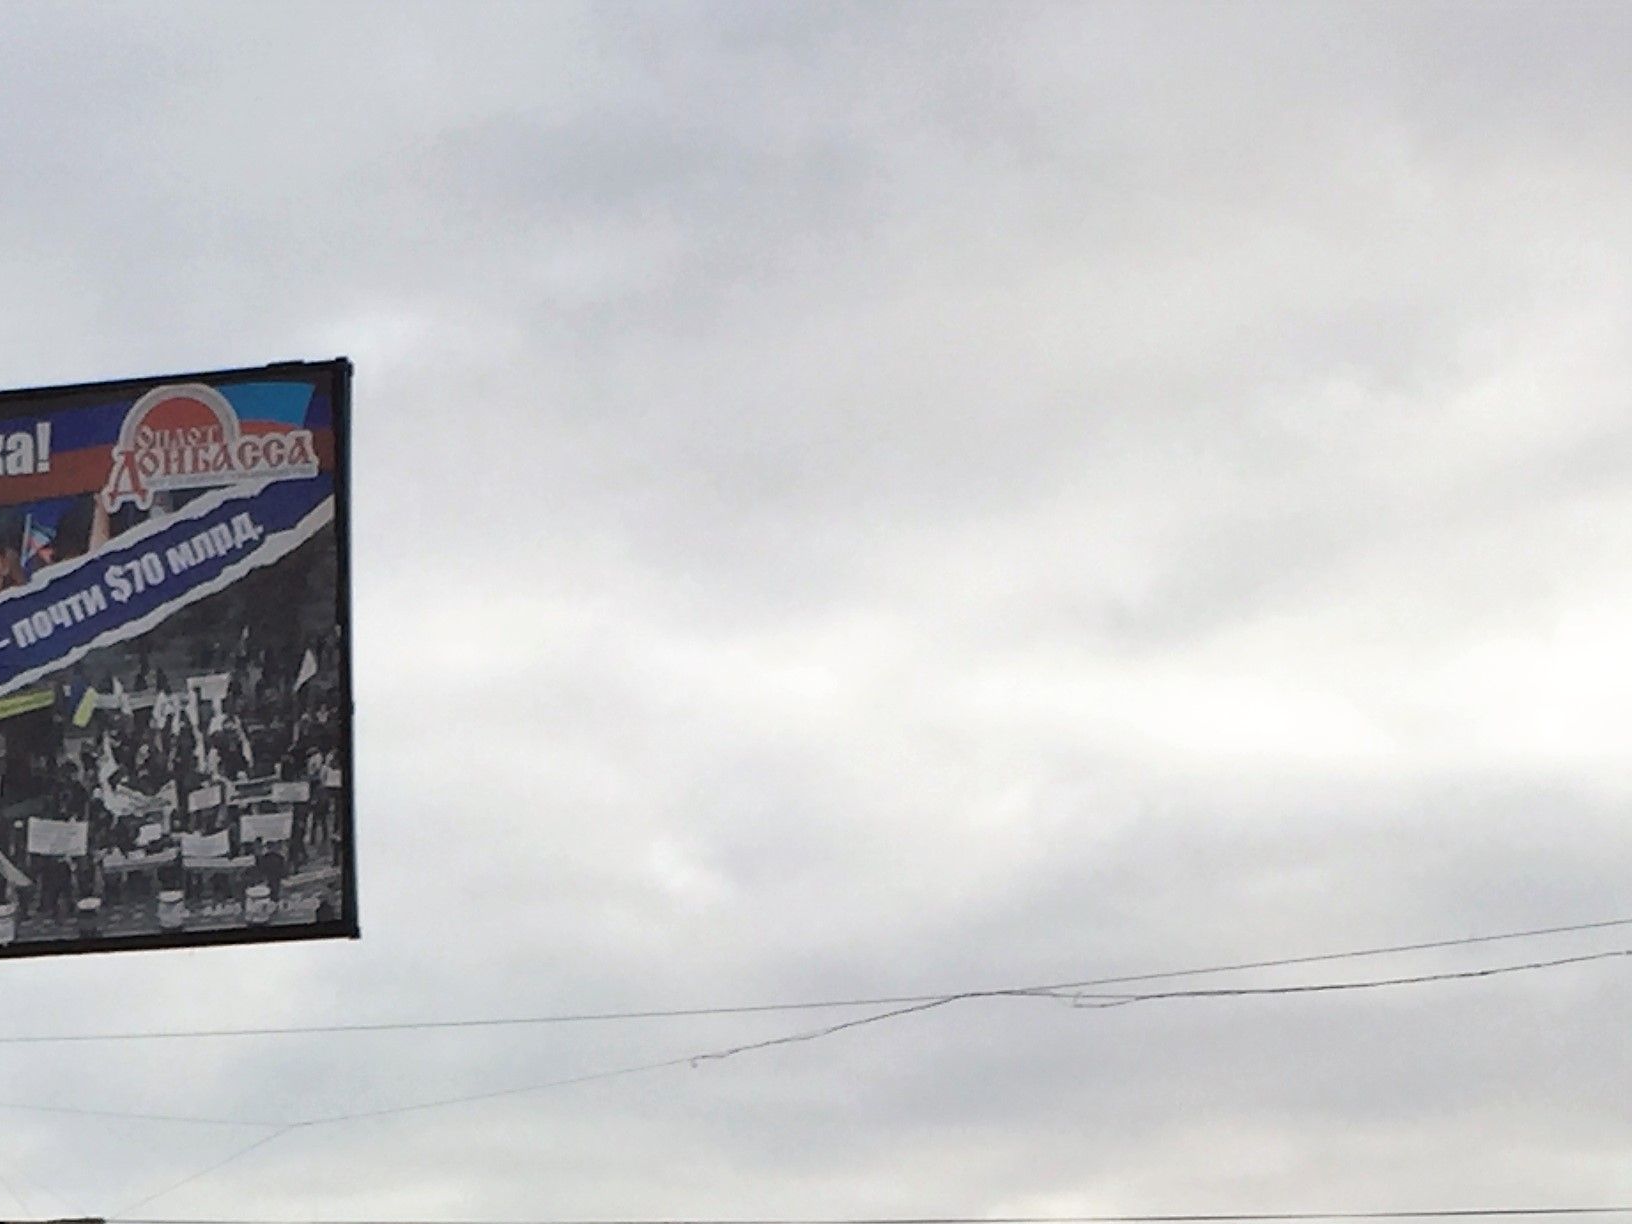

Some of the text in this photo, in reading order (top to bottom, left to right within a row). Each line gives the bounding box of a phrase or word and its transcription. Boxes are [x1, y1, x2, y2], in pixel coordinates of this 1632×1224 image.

[11, 586, 108, 649] почти
[103, 554, 166, 604] $70
[166, 511, 265, 576] млрд.
